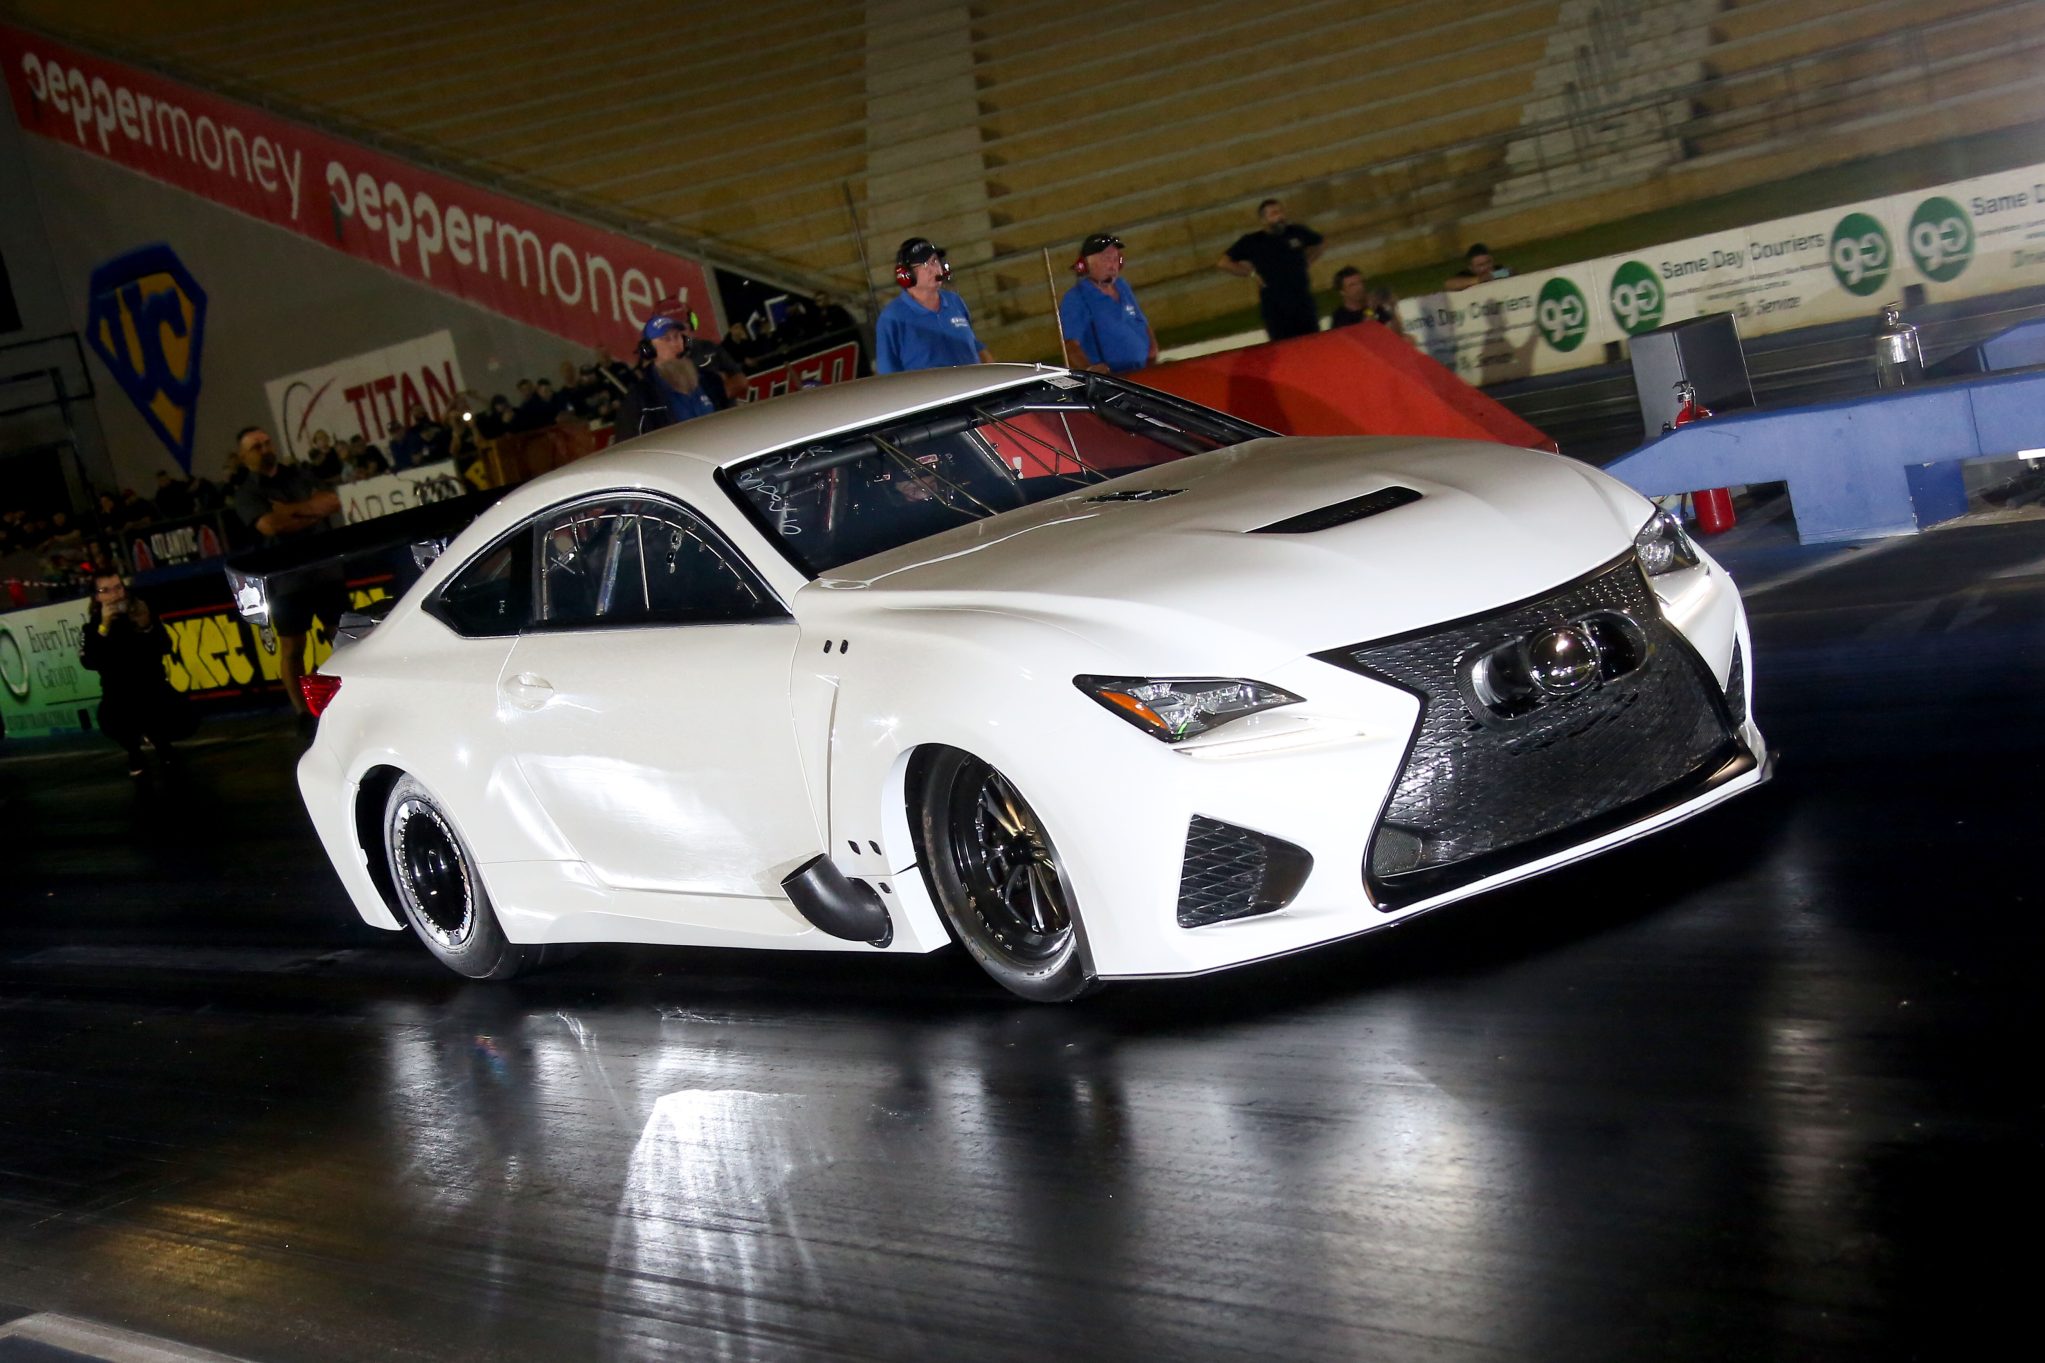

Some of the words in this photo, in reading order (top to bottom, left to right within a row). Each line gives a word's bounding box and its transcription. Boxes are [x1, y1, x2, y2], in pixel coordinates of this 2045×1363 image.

[21, 52, 300, 220] peppermoney
[1972, 193, 2028, 216] Same
[1661, 260, 1707, 280] Same
[1713, 249, 1744, 269] Day
[1750, 232, 1826, 260] Couriers
[1405, 314, 1435, 332] ame
[344, 360, 457, 442] TITAN
[25, 613, 88, 657] EveryTr
[36, 660, 79, 694] Group
